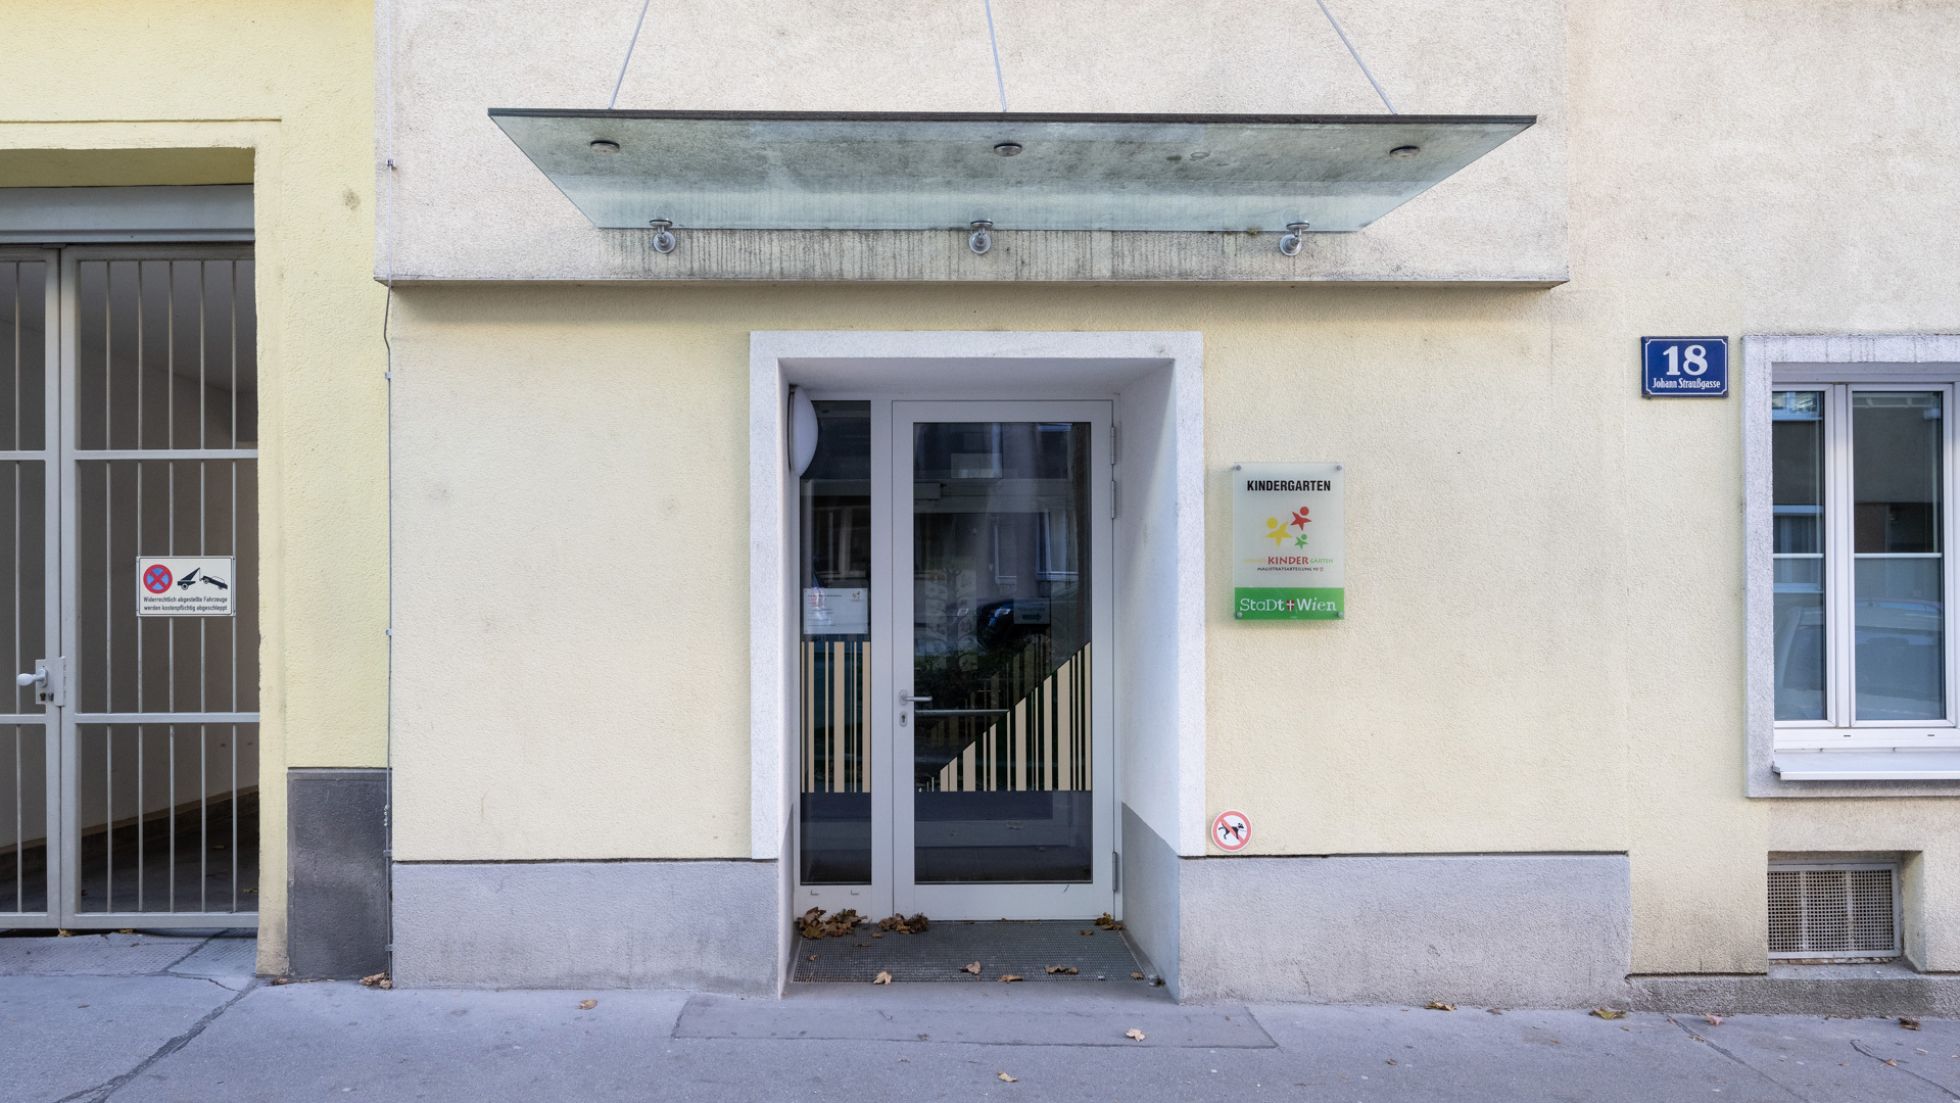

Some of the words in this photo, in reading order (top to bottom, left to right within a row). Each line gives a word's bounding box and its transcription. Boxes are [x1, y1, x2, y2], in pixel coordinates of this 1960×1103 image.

[1663, 344, 1708, 376] 18
[1652, 377, 1678, 389] Johann
[1678, 377, 1721, 390] Straußgasse
[1246, 480, 1331, 492] KINDERGARTEN
[1267, 556, 1309, 565] KINDER
[177, 596, 202, 604] abgestellte
[203, 596, 228, 604] Fahrzeuge
[1296, 597, 1337, 612] Wien
[162, 604, 196, 612] kostenpflichtig
[196, 604, 228, 612] abgeschleppt
